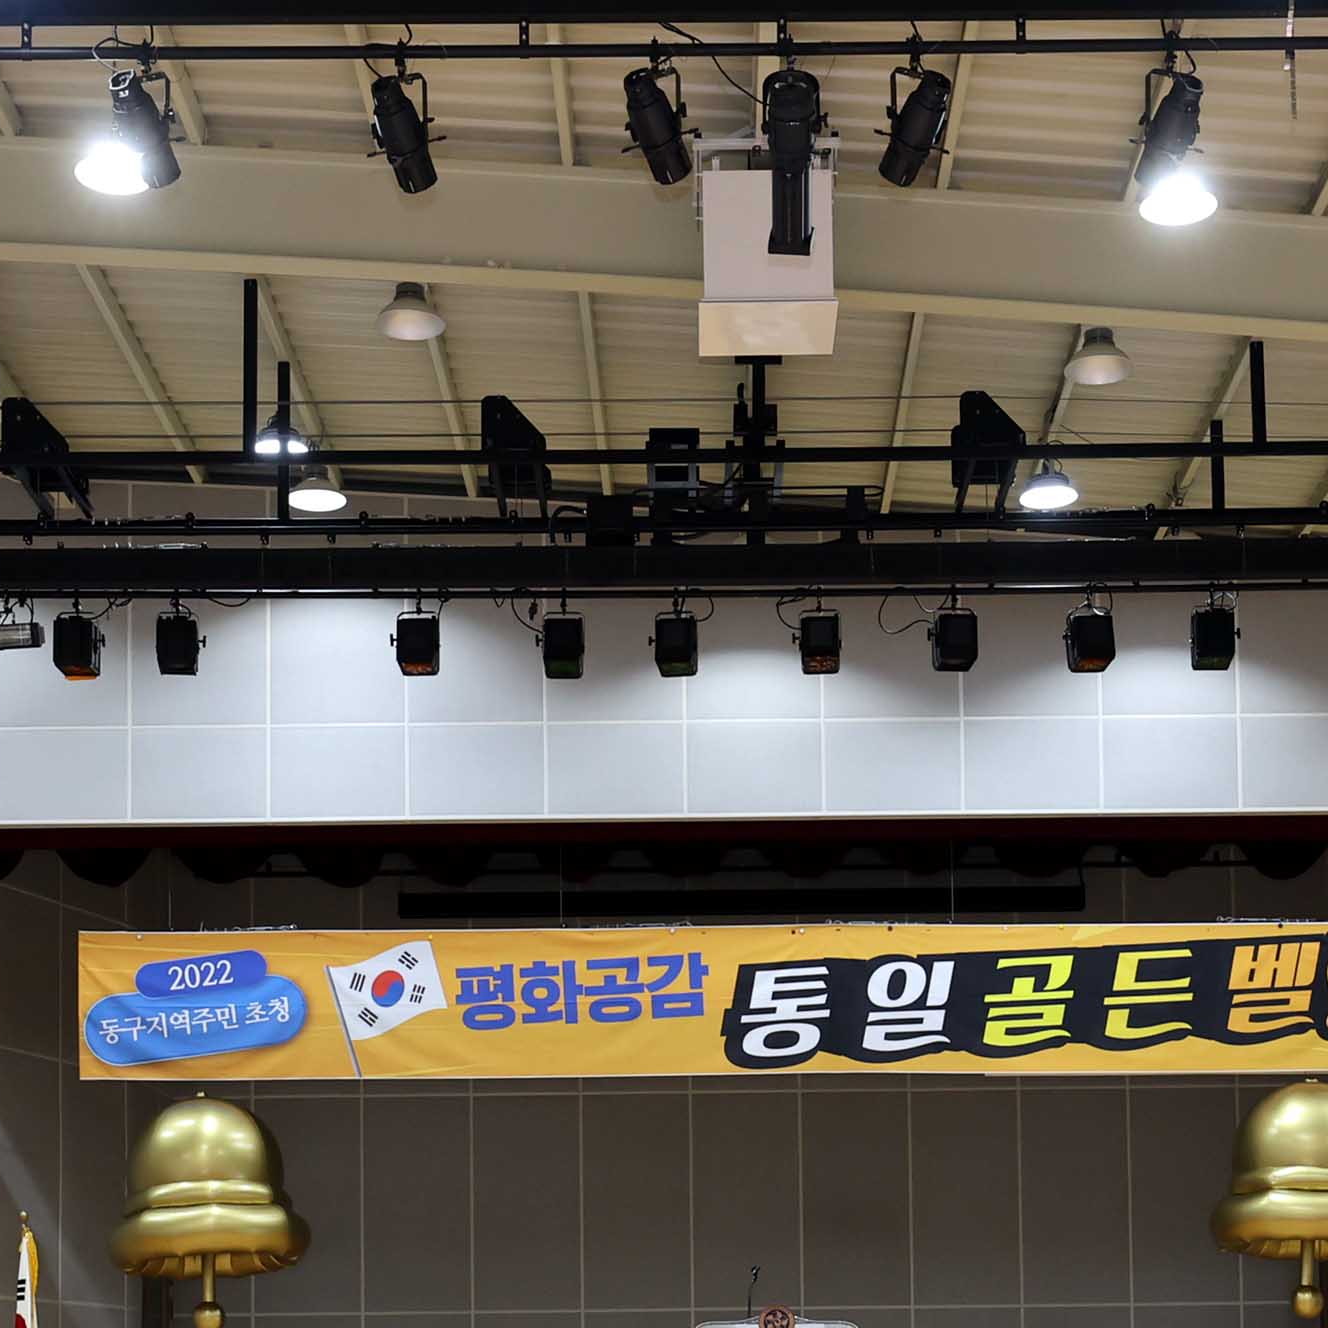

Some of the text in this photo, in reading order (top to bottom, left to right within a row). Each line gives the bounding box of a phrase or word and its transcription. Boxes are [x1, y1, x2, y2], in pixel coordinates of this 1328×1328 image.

[167, 959, 235, 991] 2022
[454, 951, 709, 1031] 평화공감
[99, 996, 291, 1045] 동구지역주민 초청
